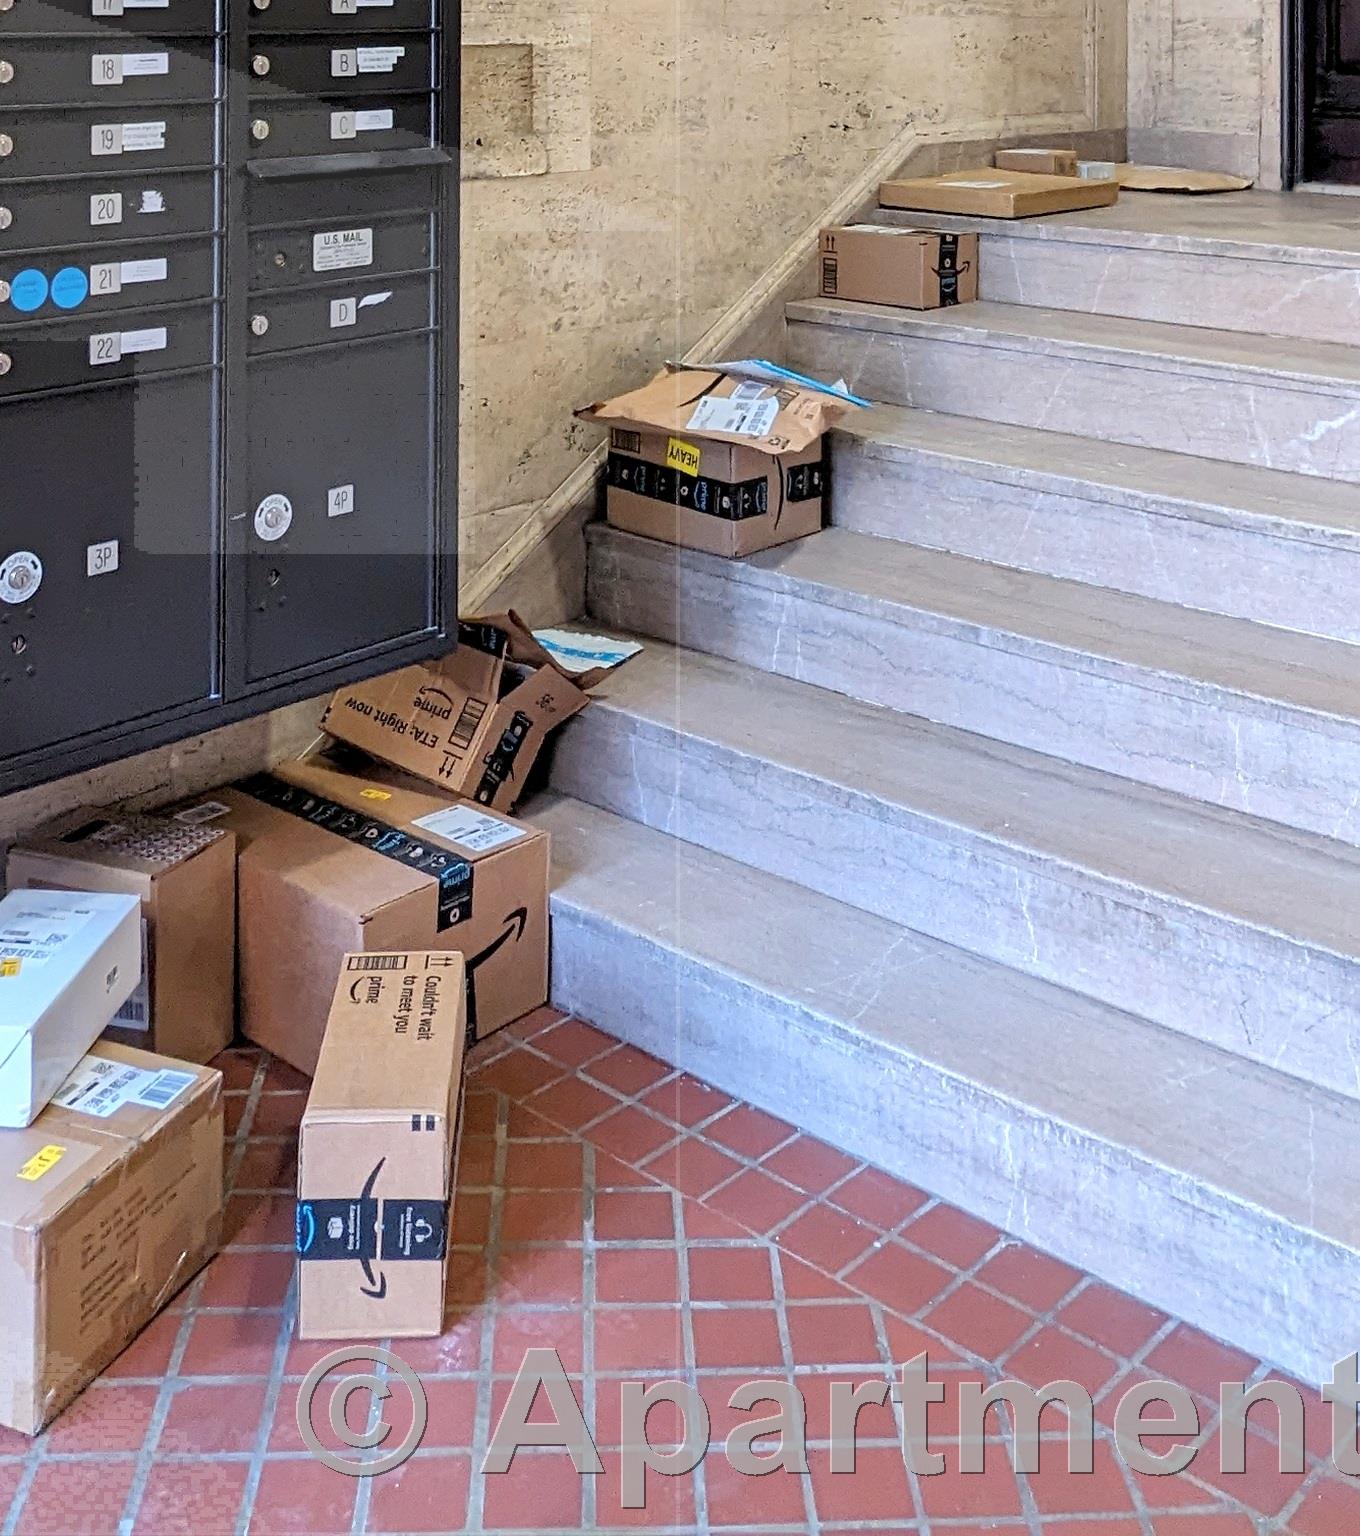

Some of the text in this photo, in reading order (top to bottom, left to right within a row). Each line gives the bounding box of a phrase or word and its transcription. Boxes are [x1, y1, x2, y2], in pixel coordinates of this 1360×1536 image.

[102, 58, 115, 80] 18
[340, 53, 349, 73] B
[340, 115, 348, 135] C
[100, 128, 114, 150] 19
[97, 197, 115, 220] 20
[323, 232, 363, 246] U.S. MAIL
[98, 268, 113, 290] 21
[338, 303, 348, 322] D
[97, 337, 113, 360] 22
[668, 445, 699, 468] HEAVY
[334, 489, 349, 508] 4P
[95, 545, 113, 571] 3P
[413, 696, 453, 720] prime
[344, 696, 440, 749] ETA: Right now
[365, 976, 385, 1004] prime
[392, 974, 419, 1034] to meet you
[416, 975, 442, 1041] Couldn't wait
